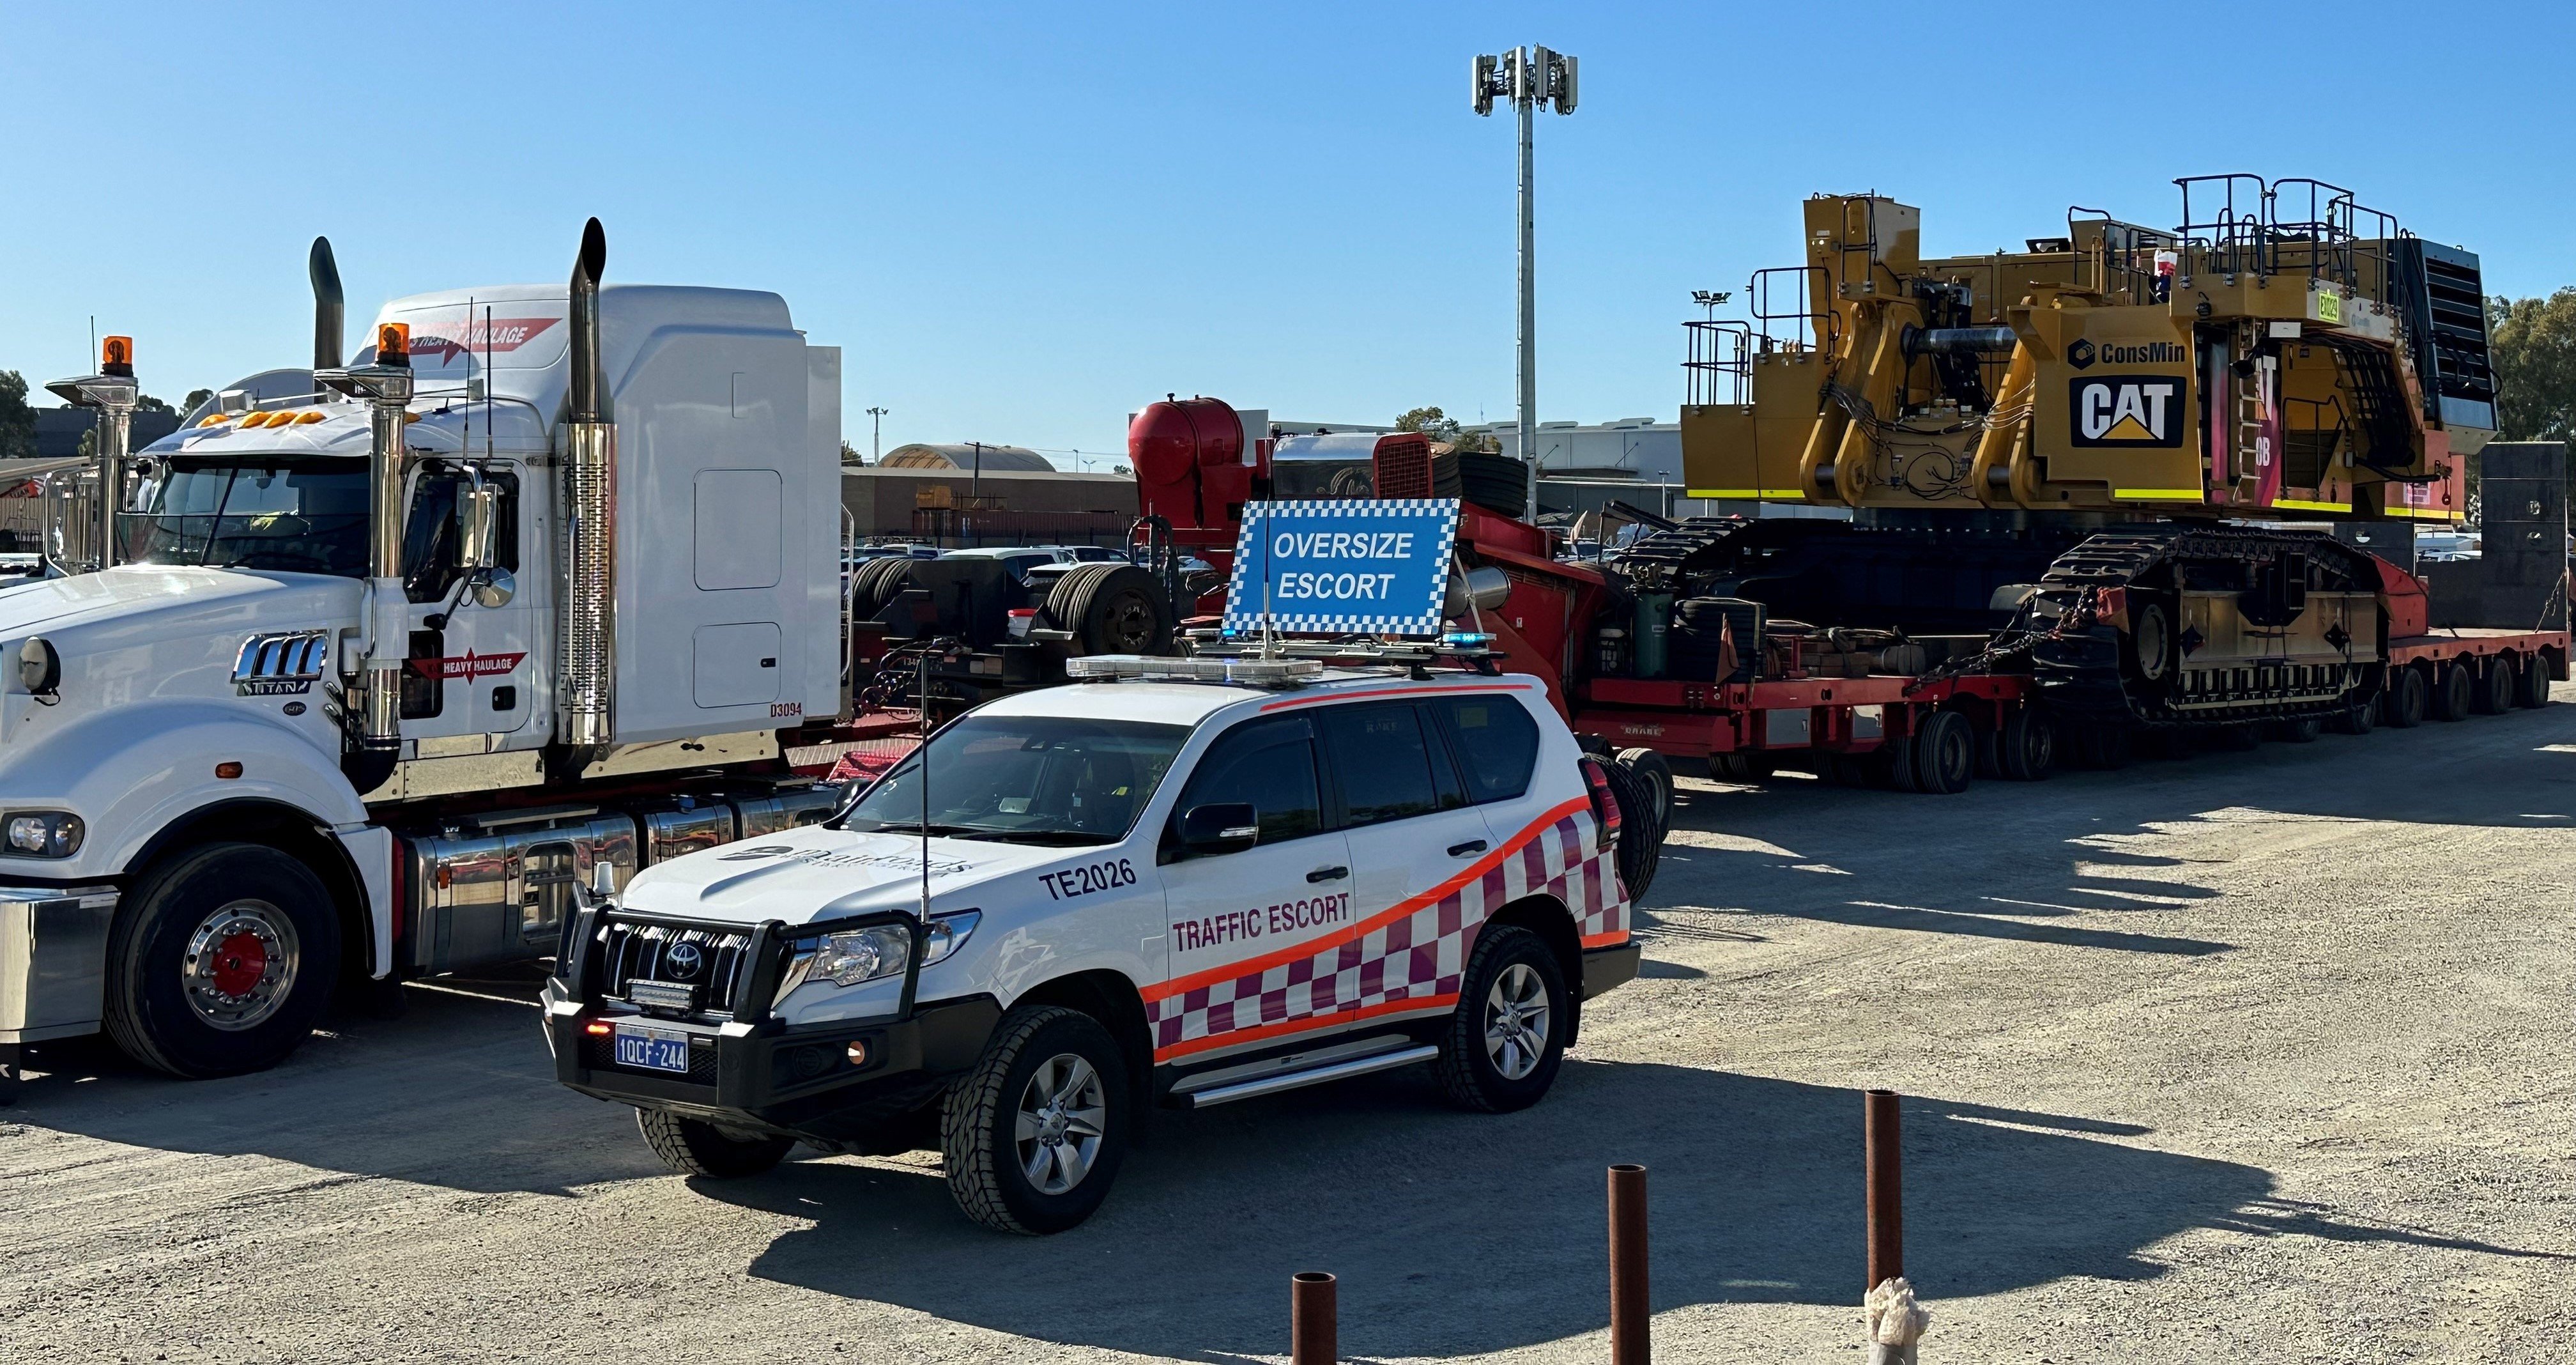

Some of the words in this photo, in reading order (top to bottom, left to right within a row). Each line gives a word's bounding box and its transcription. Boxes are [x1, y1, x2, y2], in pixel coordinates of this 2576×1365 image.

[464, 327, 528, 344] HAULAGE
[2101, 342, 2185, 364] ConsMin
[2082, 383, 2173, 440] CAT
[1274, 532, 1414, 558] OVERSIZE
[1277, 573, 1395, 599] ESCORT
[443, 661, 472, 674] HEAVY
[473, 658, 512, 671] HAULAGE
[252, 681, 296, 695] TITAN
[770, 702, 802, 717] D3094
[1038, 858, 1136, 900] TE2026
[1173, 908, 1262, 952] TRAFFIC
[1268, 893, 1349, 934] ESCORT
